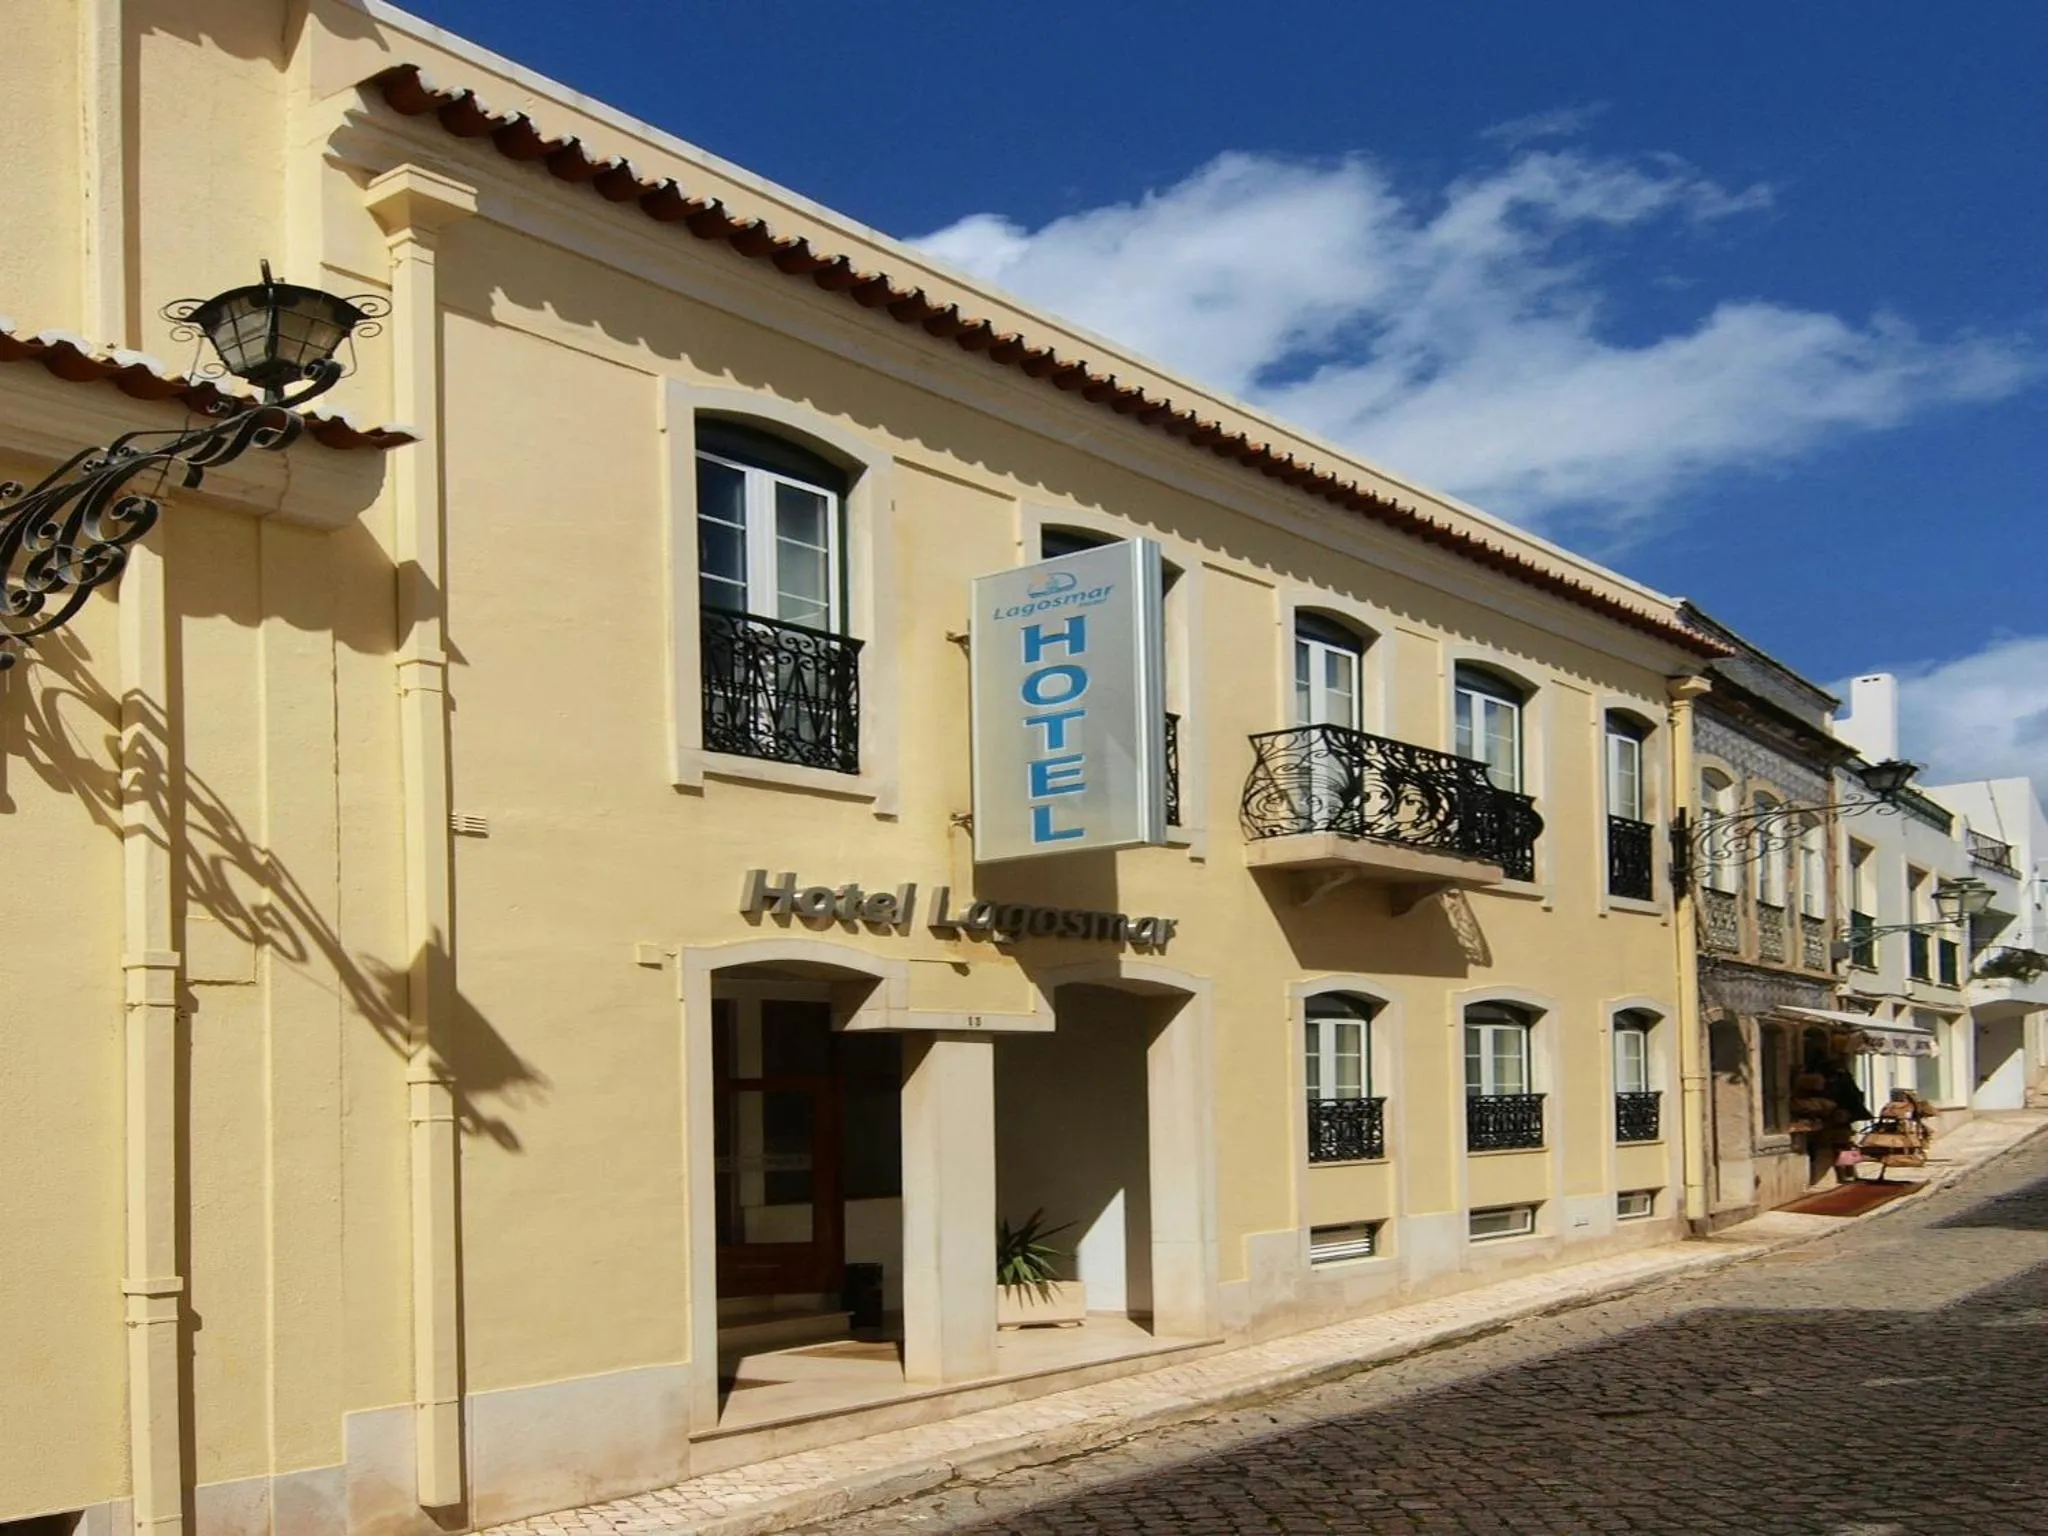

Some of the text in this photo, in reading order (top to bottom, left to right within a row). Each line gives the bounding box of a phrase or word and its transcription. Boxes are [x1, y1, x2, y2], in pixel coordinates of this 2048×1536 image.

[993, 585, 1114, 619] Lagosmar
[1020, 614, 1088, 842] HOTEL
[740, 869, 1178, 948] Hotel Lagosmar
